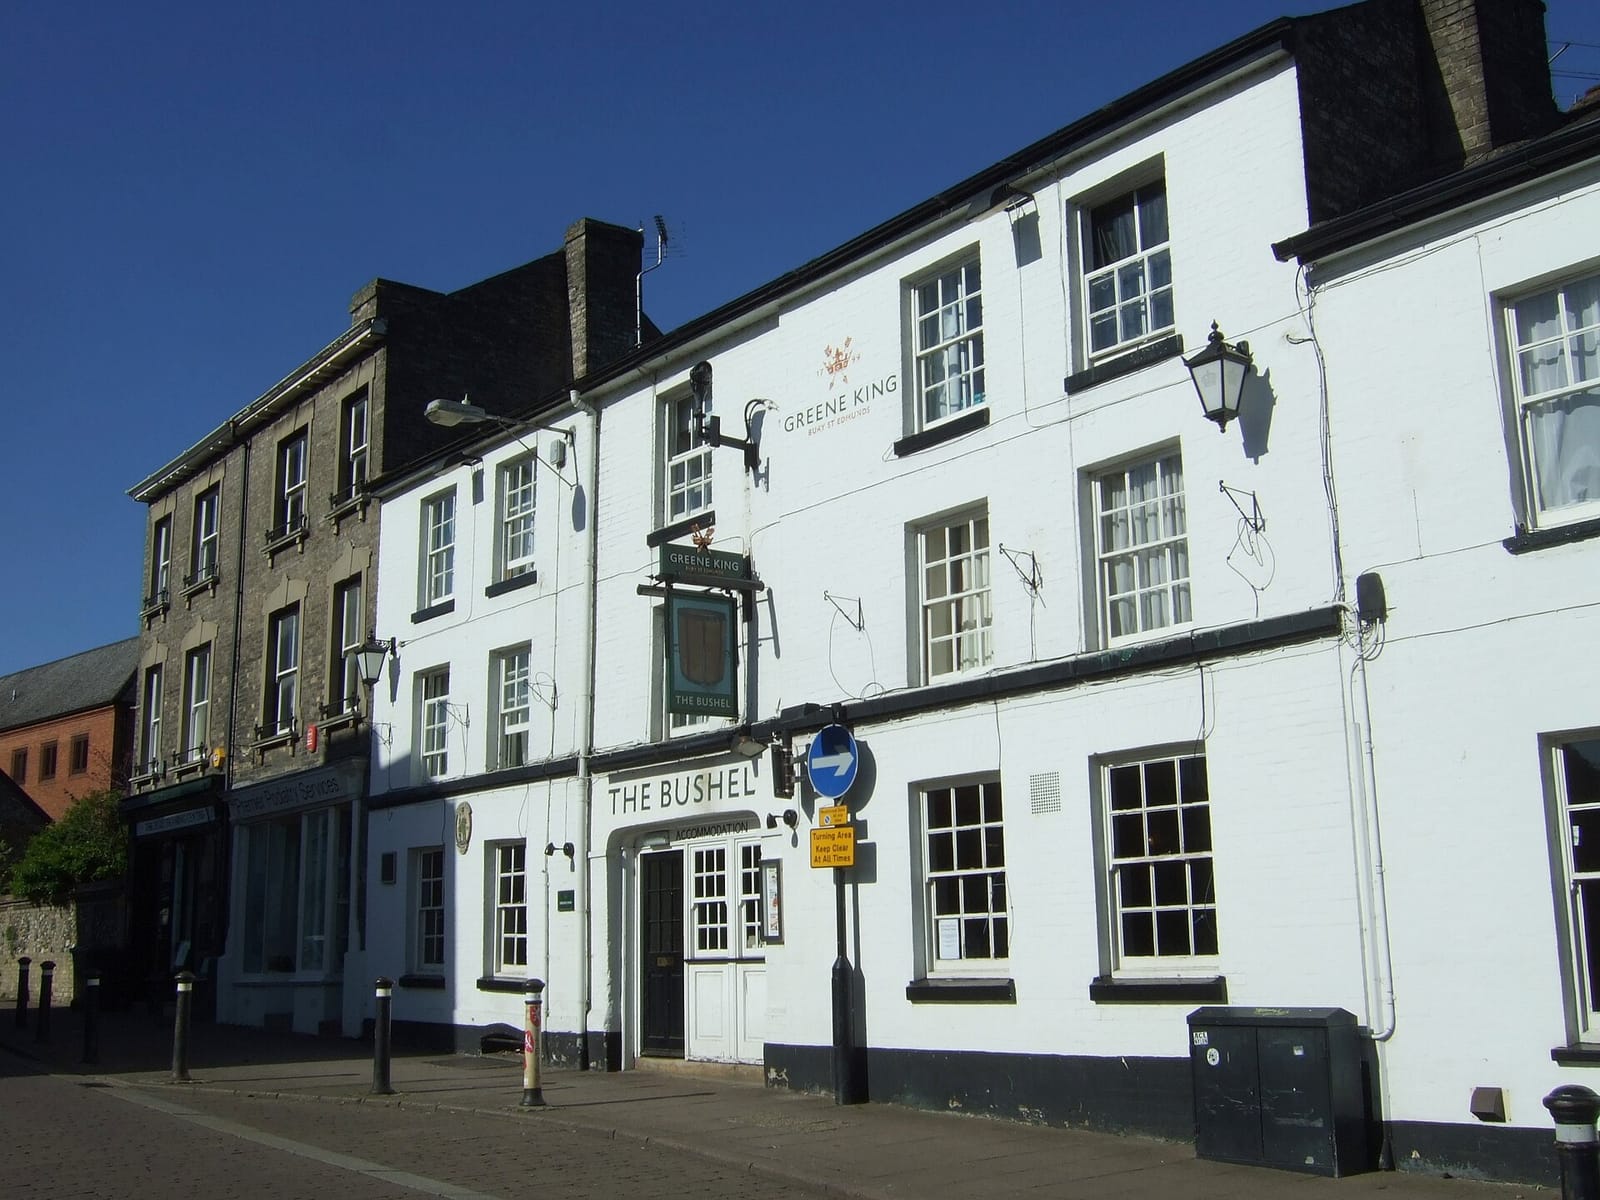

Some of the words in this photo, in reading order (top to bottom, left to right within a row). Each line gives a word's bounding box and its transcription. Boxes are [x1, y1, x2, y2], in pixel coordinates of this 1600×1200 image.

[784, 394, 847, 432] GREENE
[854, 375, 897, 406] KING
[827, 419, 836, 429] ST
[837, 405, 871, 425] EDMUNDS
[670, 553, 710, 567] GREENE
[714, 560, 739, 571] KING
[675, 695, 694, 705] THE
[696, 696, 731, 709] BUSHEL
[298, 777, 339, 802] Services
[608, 783, 651, 815] THE
[660, 767, 756, 808] BUSHEL
[675, 821, 749, 841] ACCOMMODATION
[813, 832, 836, 842] Turning
[837, 831, 852, 840] Area
[815, 855, 821, 863] At
[833, 854, 851, 863] Times
[816, 845, 831, 854] Keep
[832, 844, 849, 853] Clear
